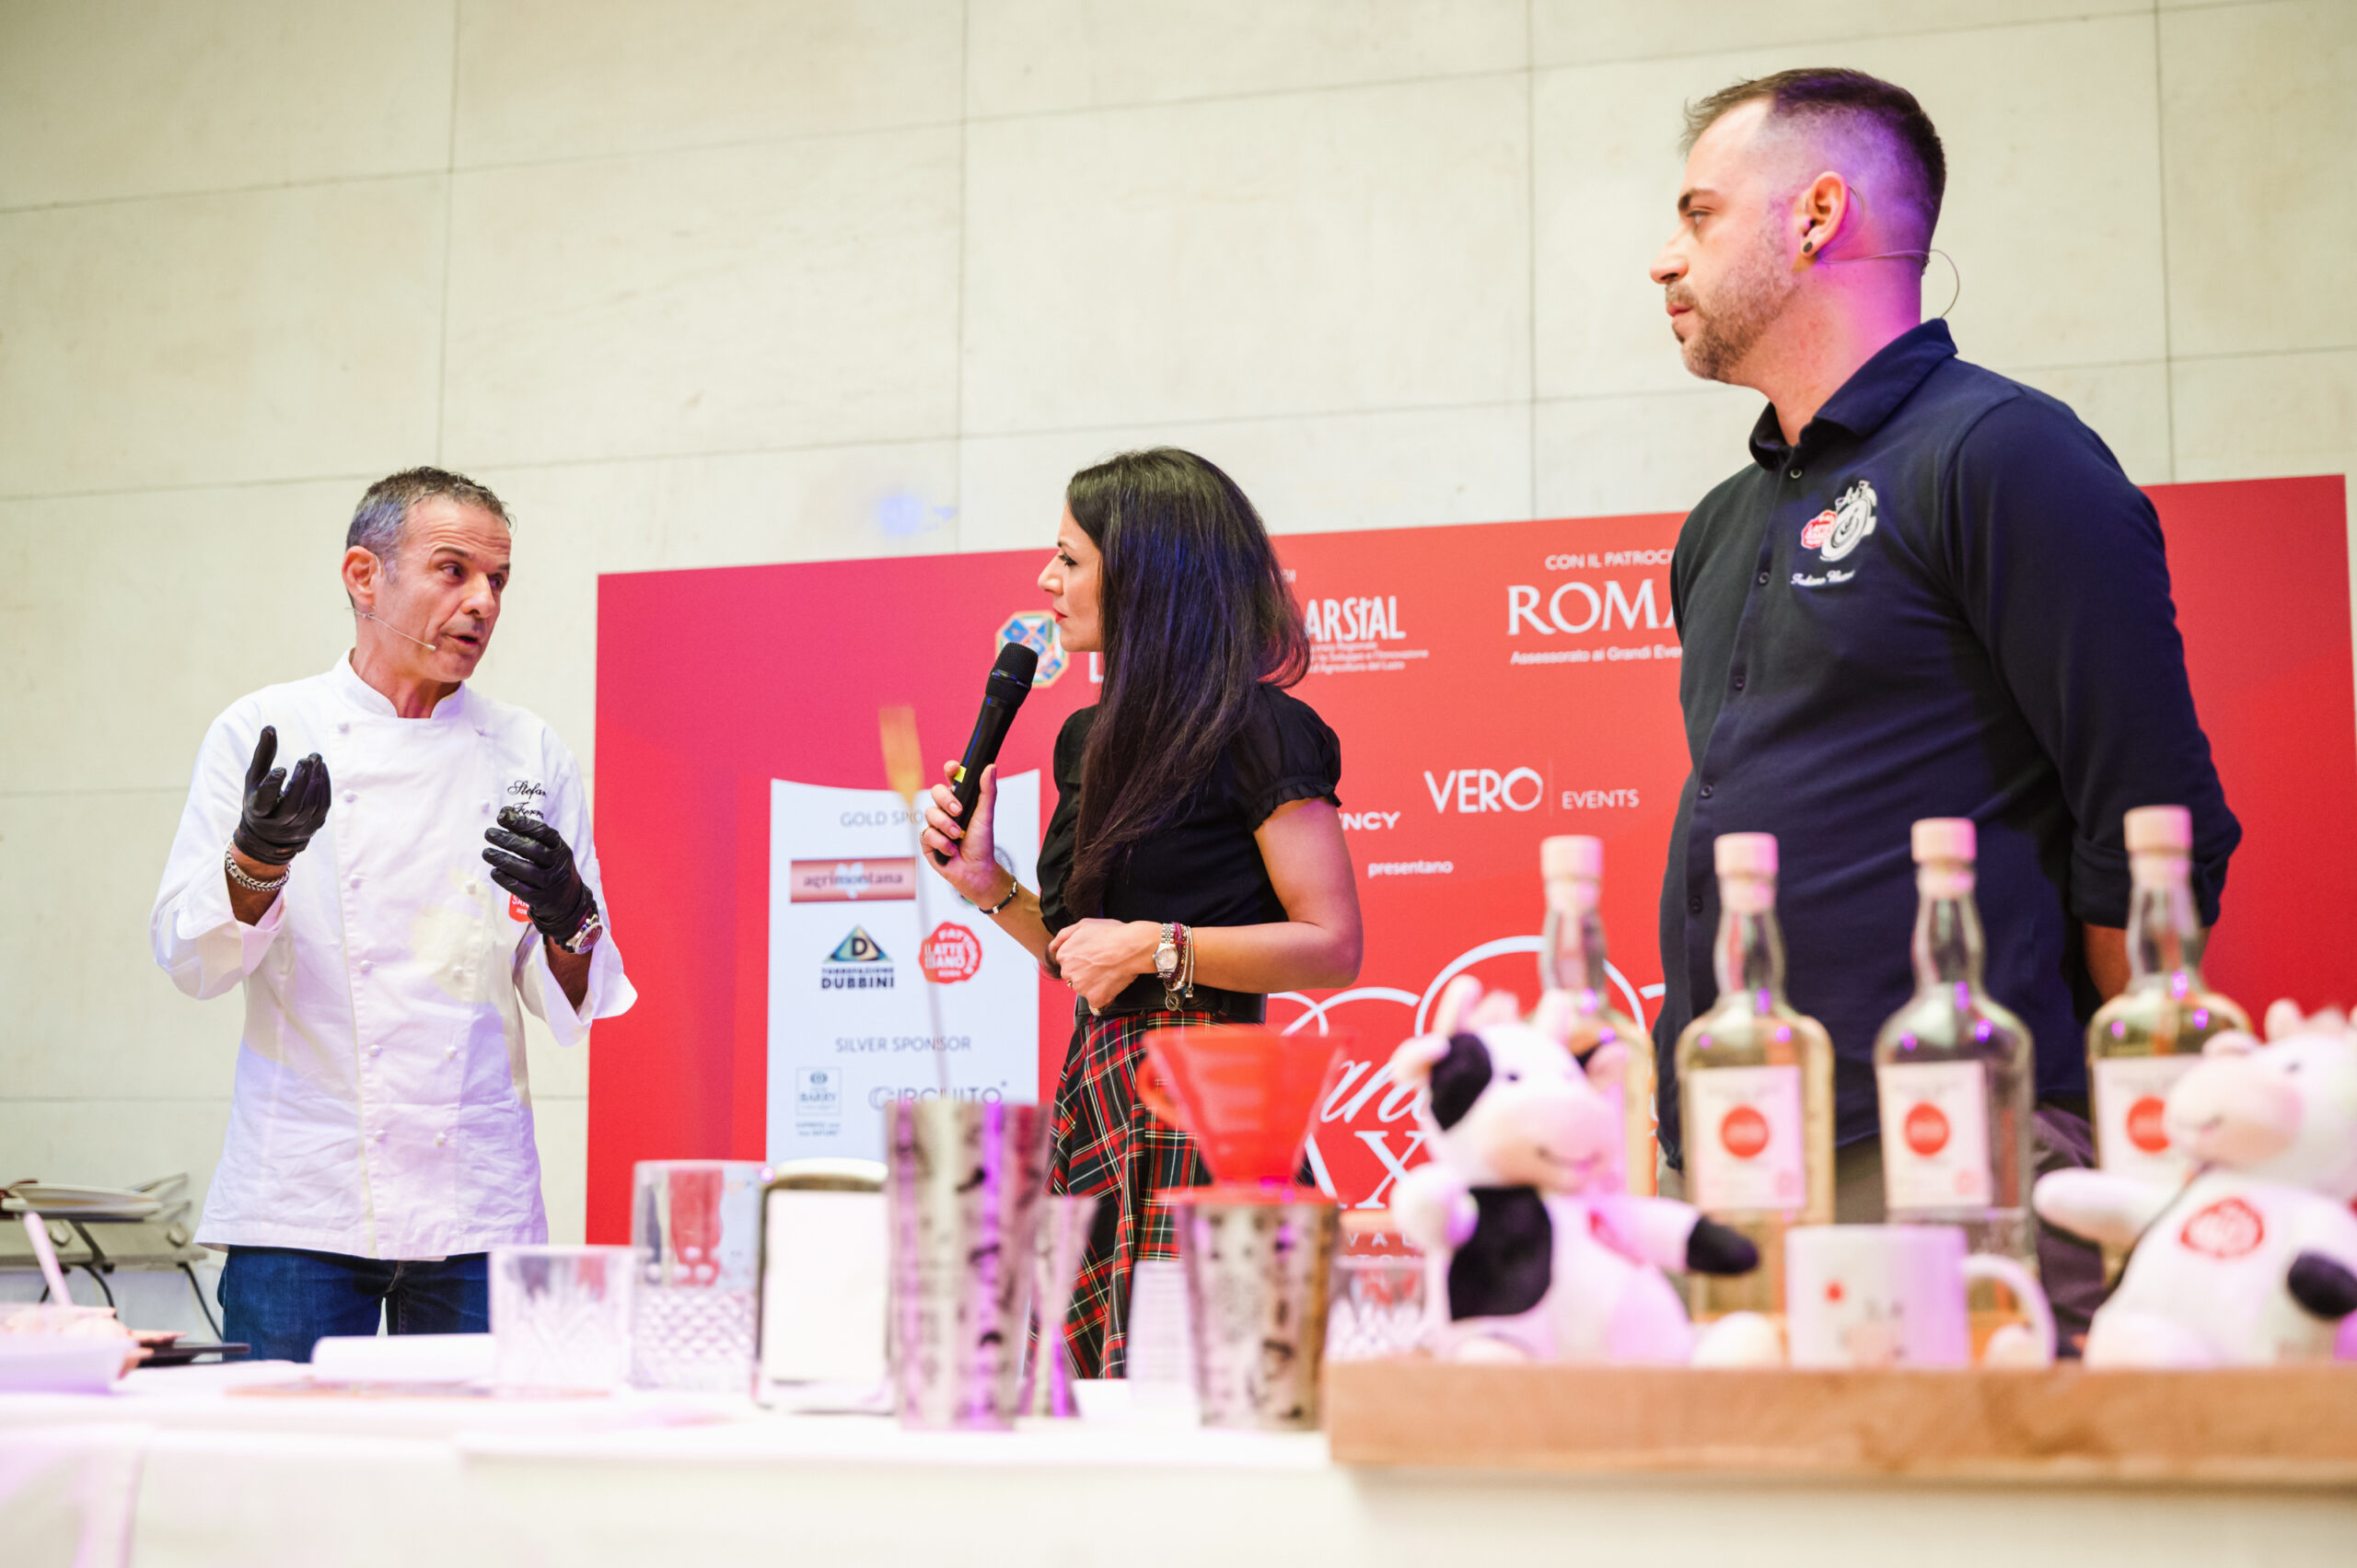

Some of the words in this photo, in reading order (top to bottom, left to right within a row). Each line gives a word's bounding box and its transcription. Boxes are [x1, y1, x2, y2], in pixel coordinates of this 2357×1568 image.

[1545, 554, 1585, 571] CON
[1587, 552, 1602, 568] IL
[1510, 650, 1590, 665] Assessorato
[1592, 647, 1605, 662] ai
[1607, 645, 1652, 661] Grandi
[1423, 767, 1544, 814] VERO
[1562, 789, 1640, 809] EVENTS
[840, 809, 888, 827] GOLD
[1367, 859, 1454, 878] presentano
[804, 871, 903, 888] agrimontana
[852, 937, 868, 956] D
[821, 976, 894, 989] DUBBINI
[835, 1037, 887, 1052] SILVER
[891, 1036, 971, 1051] SPONSOR
